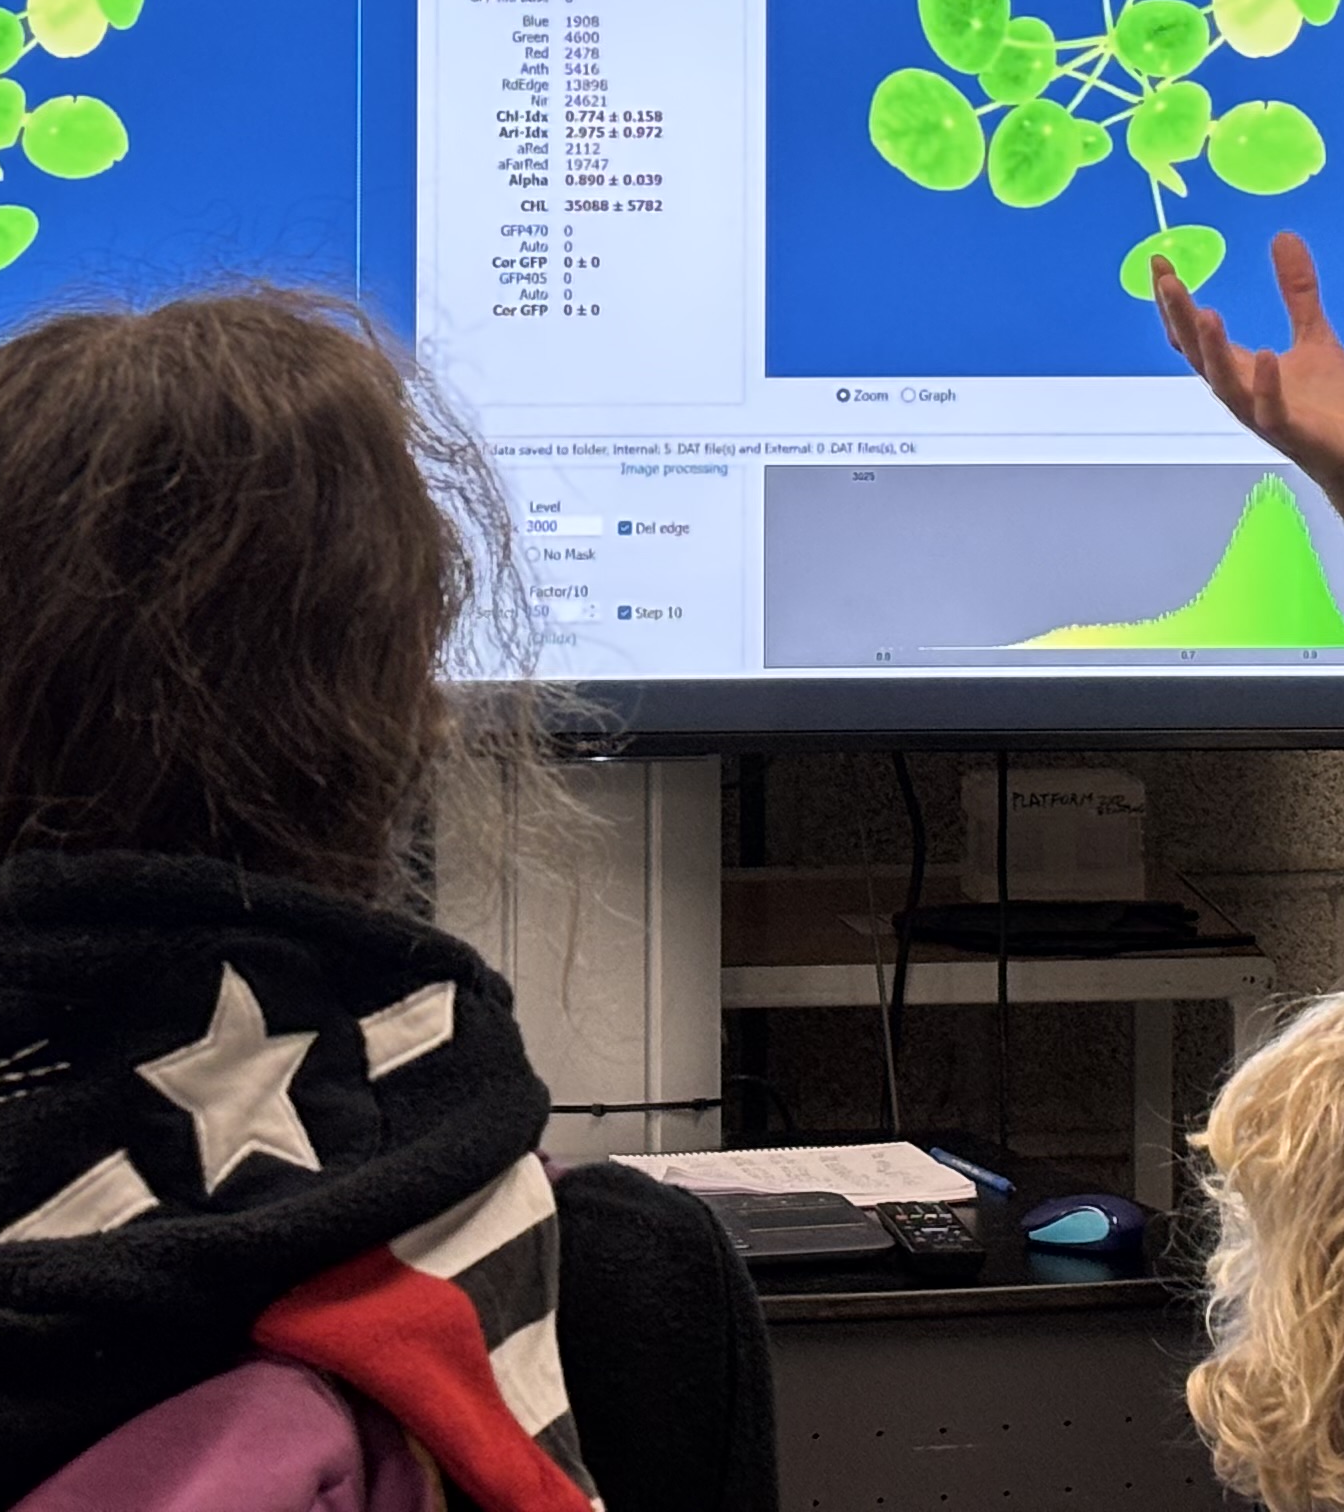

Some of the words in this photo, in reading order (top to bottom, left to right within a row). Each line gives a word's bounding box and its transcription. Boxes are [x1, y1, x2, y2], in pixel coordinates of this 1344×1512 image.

[525, 48, 549, 59] Red
[565, 48, 599, 59] 2478
[565, 111, 605, 123] 0.774
[623, 111, 663, 123] 0.158
[509, 175, 548, 188] Alpha
[565, 175, 605, 186] 0.890
[623, 175, 662, 186] 0.039
[520, 200, 548, 212] CHL
[564, 201, 609, 212] 35088
[627, 201, 663, 212] 5782
[854, 390, 888, 402] Zoom
[919, 389, 955, 405] Graph
[621, 463, 658, 477] Image
[663, 462, 728, 478] processing
[530, 501, 561, 514] Level
[526, 520, 558, 533] 3000
[544, 549, 560, 561] No
[565, 549, 596, 561] Mask
[1012, 792, 1093, 811] PLATFORM
